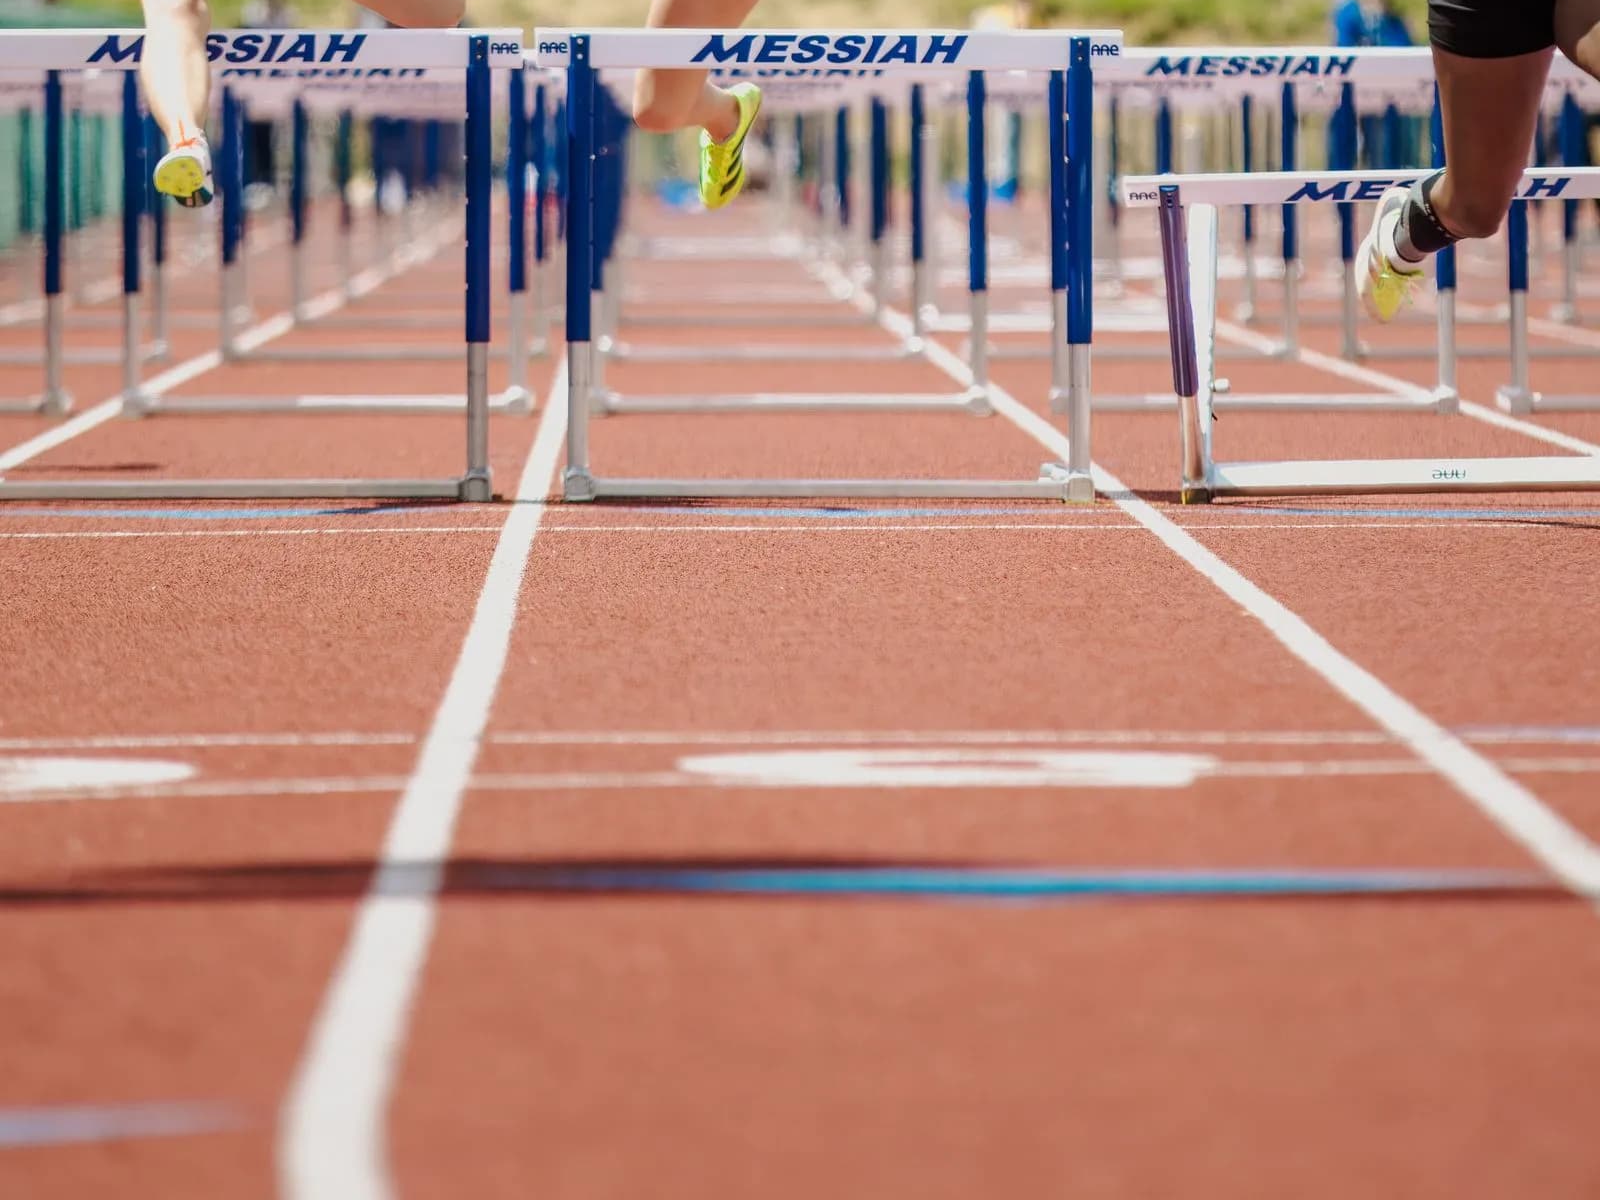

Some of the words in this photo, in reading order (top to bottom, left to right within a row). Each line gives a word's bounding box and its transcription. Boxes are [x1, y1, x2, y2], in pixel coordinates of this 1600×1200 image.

[86, 34, 367, 63] MSSIAH
[690, 35, 969, 64] MESSIAH
[1145, 55, 1357, 76] MESSIAH
